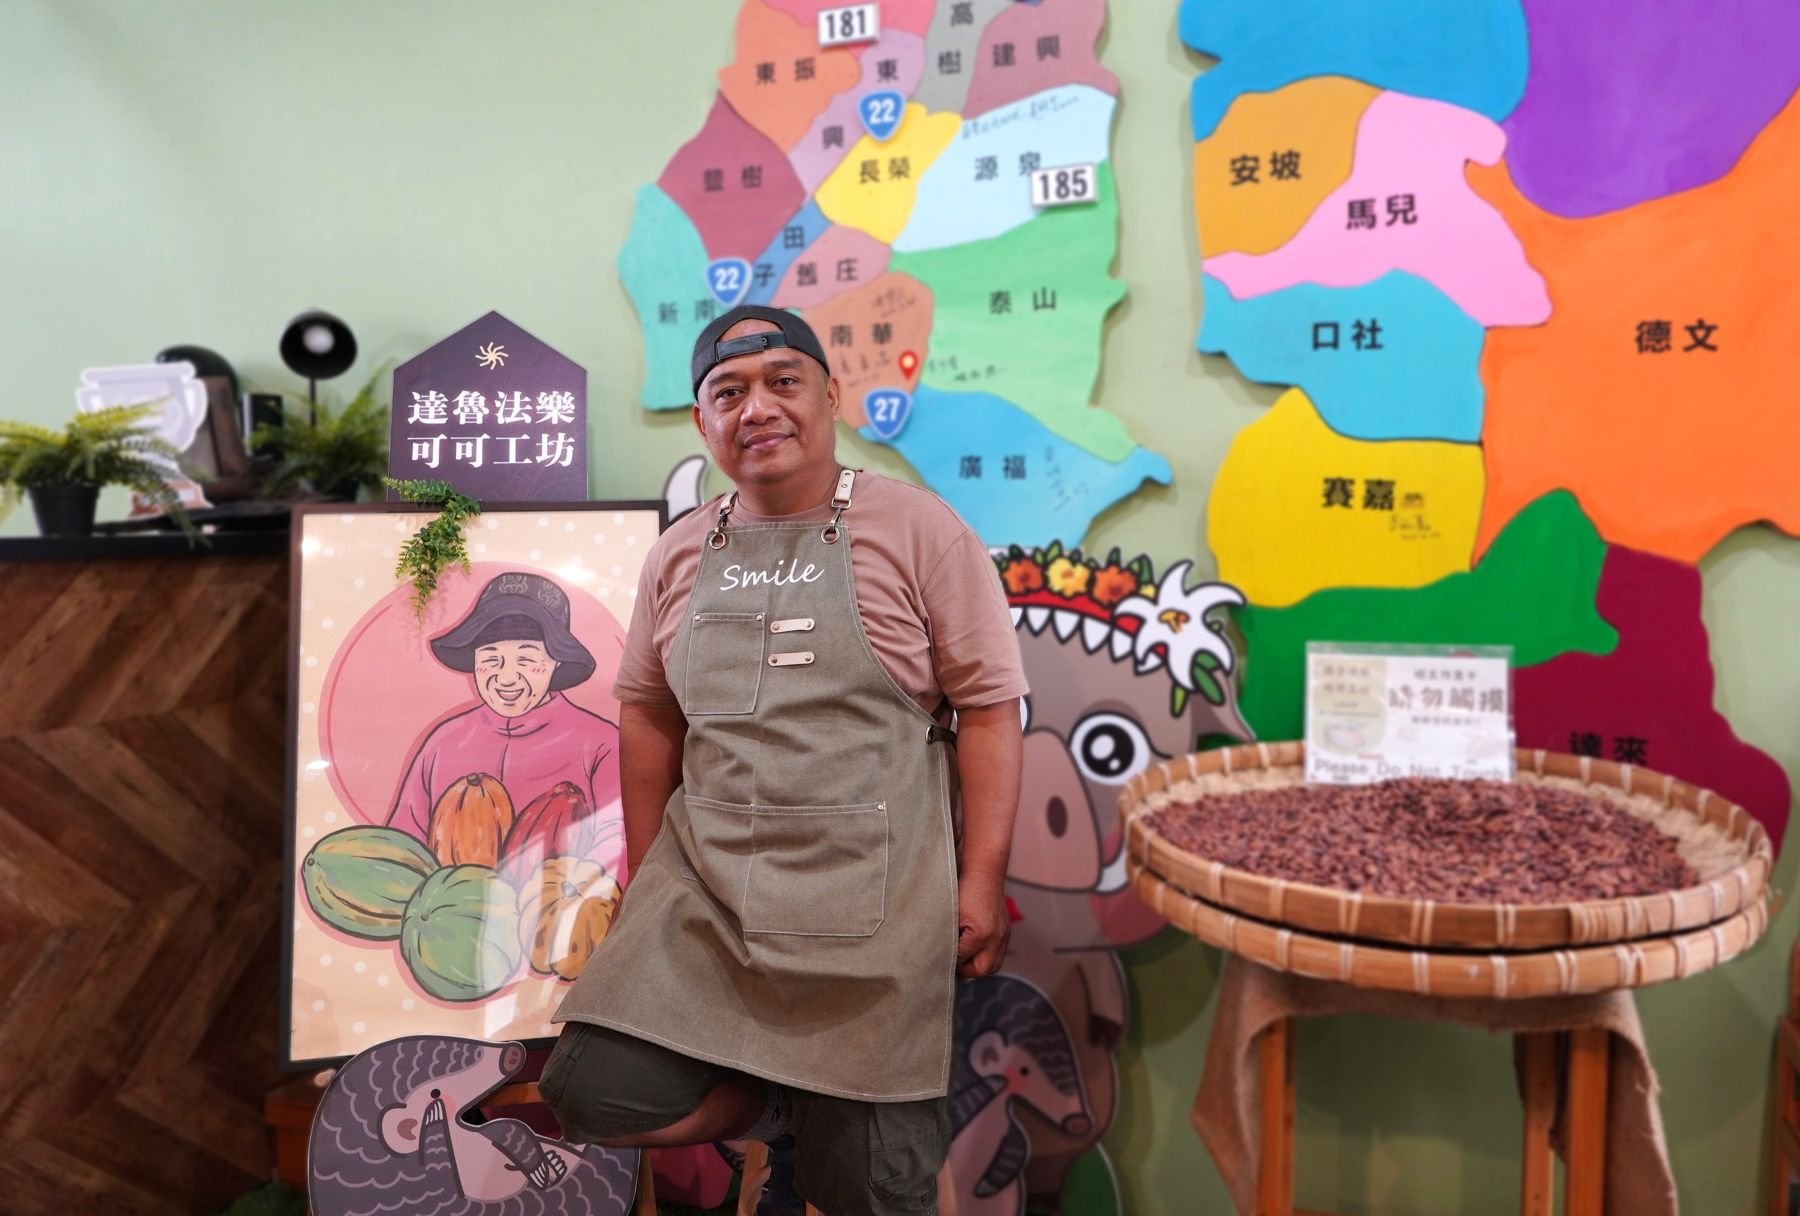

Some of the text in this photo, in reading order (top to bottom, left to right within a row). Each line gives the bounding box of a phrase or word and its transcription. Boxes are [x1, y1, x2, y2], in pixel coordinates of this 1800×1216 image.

[826, 8, 866, 39] 181
[938, 1, 974, 75] 高樹
[992, 35, 1060, 68] 建興
[756, 57, 816, 85] 東振
[868, 98, 896, 125] 22
[860, 156, 910, 184] 長榮
[1230, 149, 1302, 186] 安坡
[1040, 168, 1089, 201] 185
[1346, 194, 1418, 230] 馬兒
[715, 267, 740, 291] 22
[989, 287, 1057, 314] 泰山
[830, 322, 892, 347] 南華
[1313, 319, 1384, 351] 口社
[1635, 319, 1719, 353] 德文
[408, 390, 576, 426] 達魯法樂
[875, 398, 900, 422] 27
[408, 432, 576, 469] 可可工坊
[959, 455, 1027, 480] 廣福
[1322, 476, 1396, 511] 賽嘉
[719, 558, 825, 591] Smile
[1315, 758, 1368, 774] Please
[1377, 762, 1401, 776] Do
